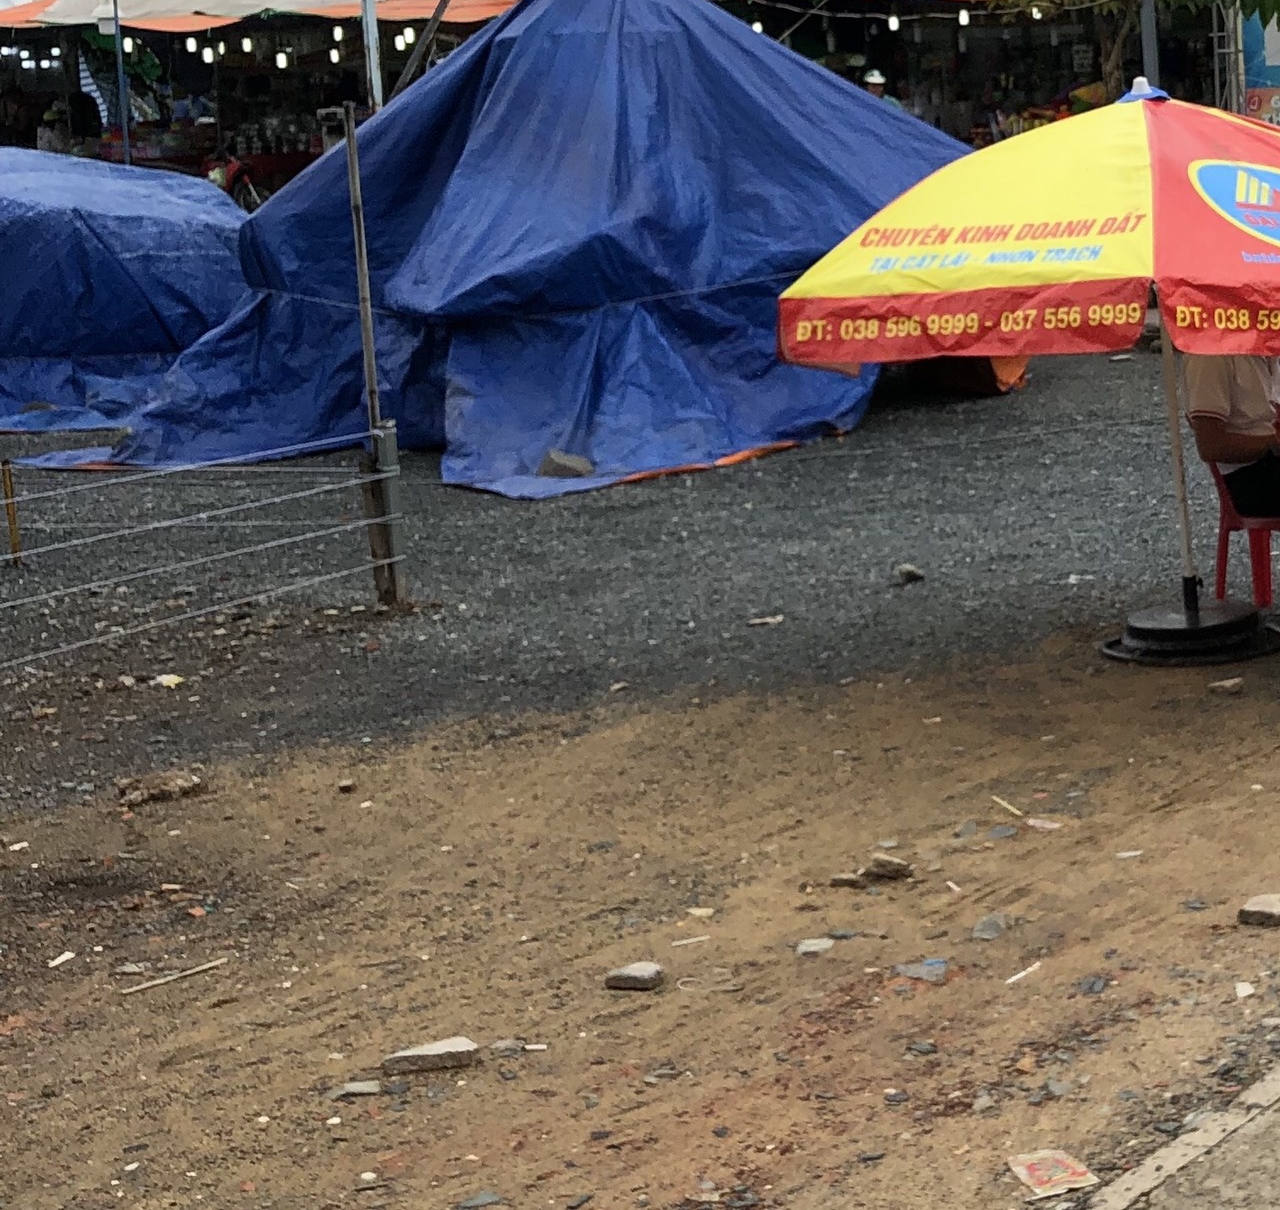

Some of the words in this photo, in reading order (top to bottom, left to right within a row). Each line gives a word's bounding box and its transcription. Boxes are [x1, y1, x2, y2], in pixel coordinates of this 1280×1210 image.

[859, 224, 952, 249] CHUYÊN
[954, 224, 1013, 245] KINH
[1014, 218, 1098, 241] DOANH
[1099, 206, 1147, 236] ĐẤT
[983, 249, 1040, 266] NHƠN
[1041, 245, 1104, 265] TRẠCH
[796, 320, 833, 342] ĐT:
[840, 319, 879, 340] 038
[885, 317, 921, 339] 596
[926, 313, 979, 336] 9999
[1000, 309, 1037, 332] 037
[1043, 306, 1082, 329] 556
[1087, 303, 1142, 326] 9999
[1176, 306, 1209, 329] ĐT:
[1214, 308, 1251, 330] 038
